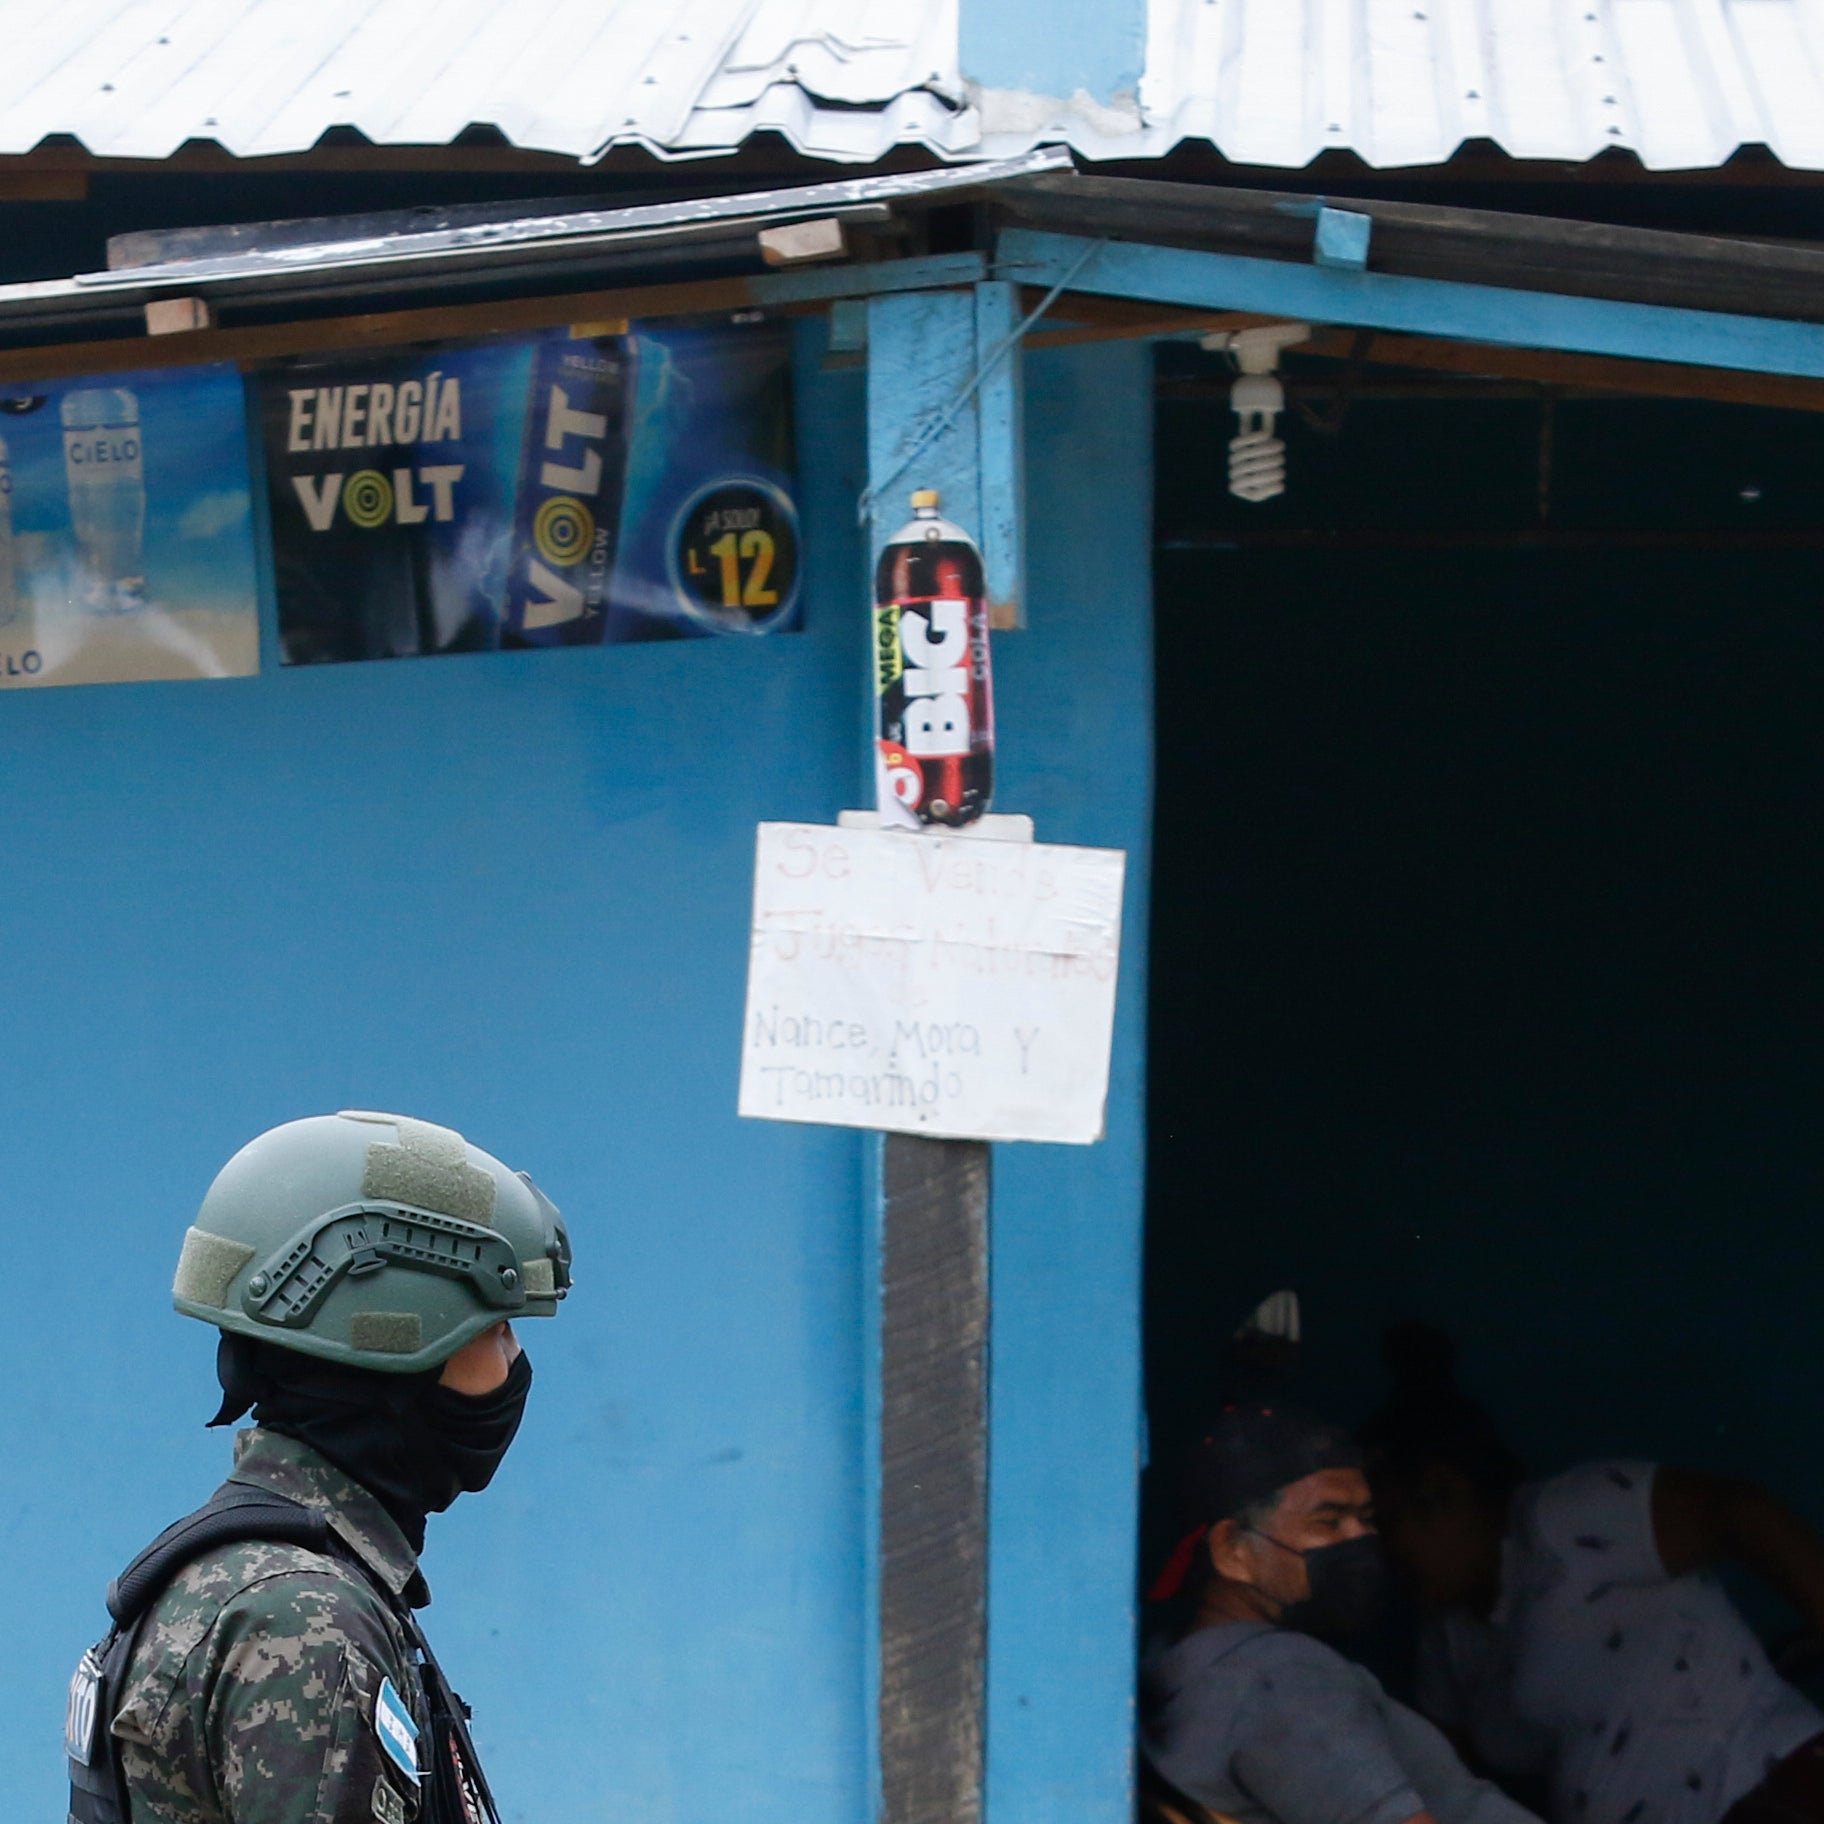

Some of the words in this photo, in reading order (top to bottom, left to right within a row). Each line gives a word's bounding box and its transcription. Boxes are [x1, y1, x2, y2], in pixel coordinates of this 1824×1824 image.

[288, 371, 462, 453] ENERGÍA
[69, 438, 141, 464] CIELO
[291, 463, 466, 532] VOLT
[522, 383, 608, 630] VOLT
[583, 526, 611, 619] YELLOW
[687, 548, 706, 575] L
[710, 529, 778, 608] 12
[879, 609, 896, 684] MEGA
[900, 600, 971, 756] BIG
[971, 614, 988, 682] COLA
[777, 828, 851, 878] Se
[888, 1020, 980, 1058] Mora
